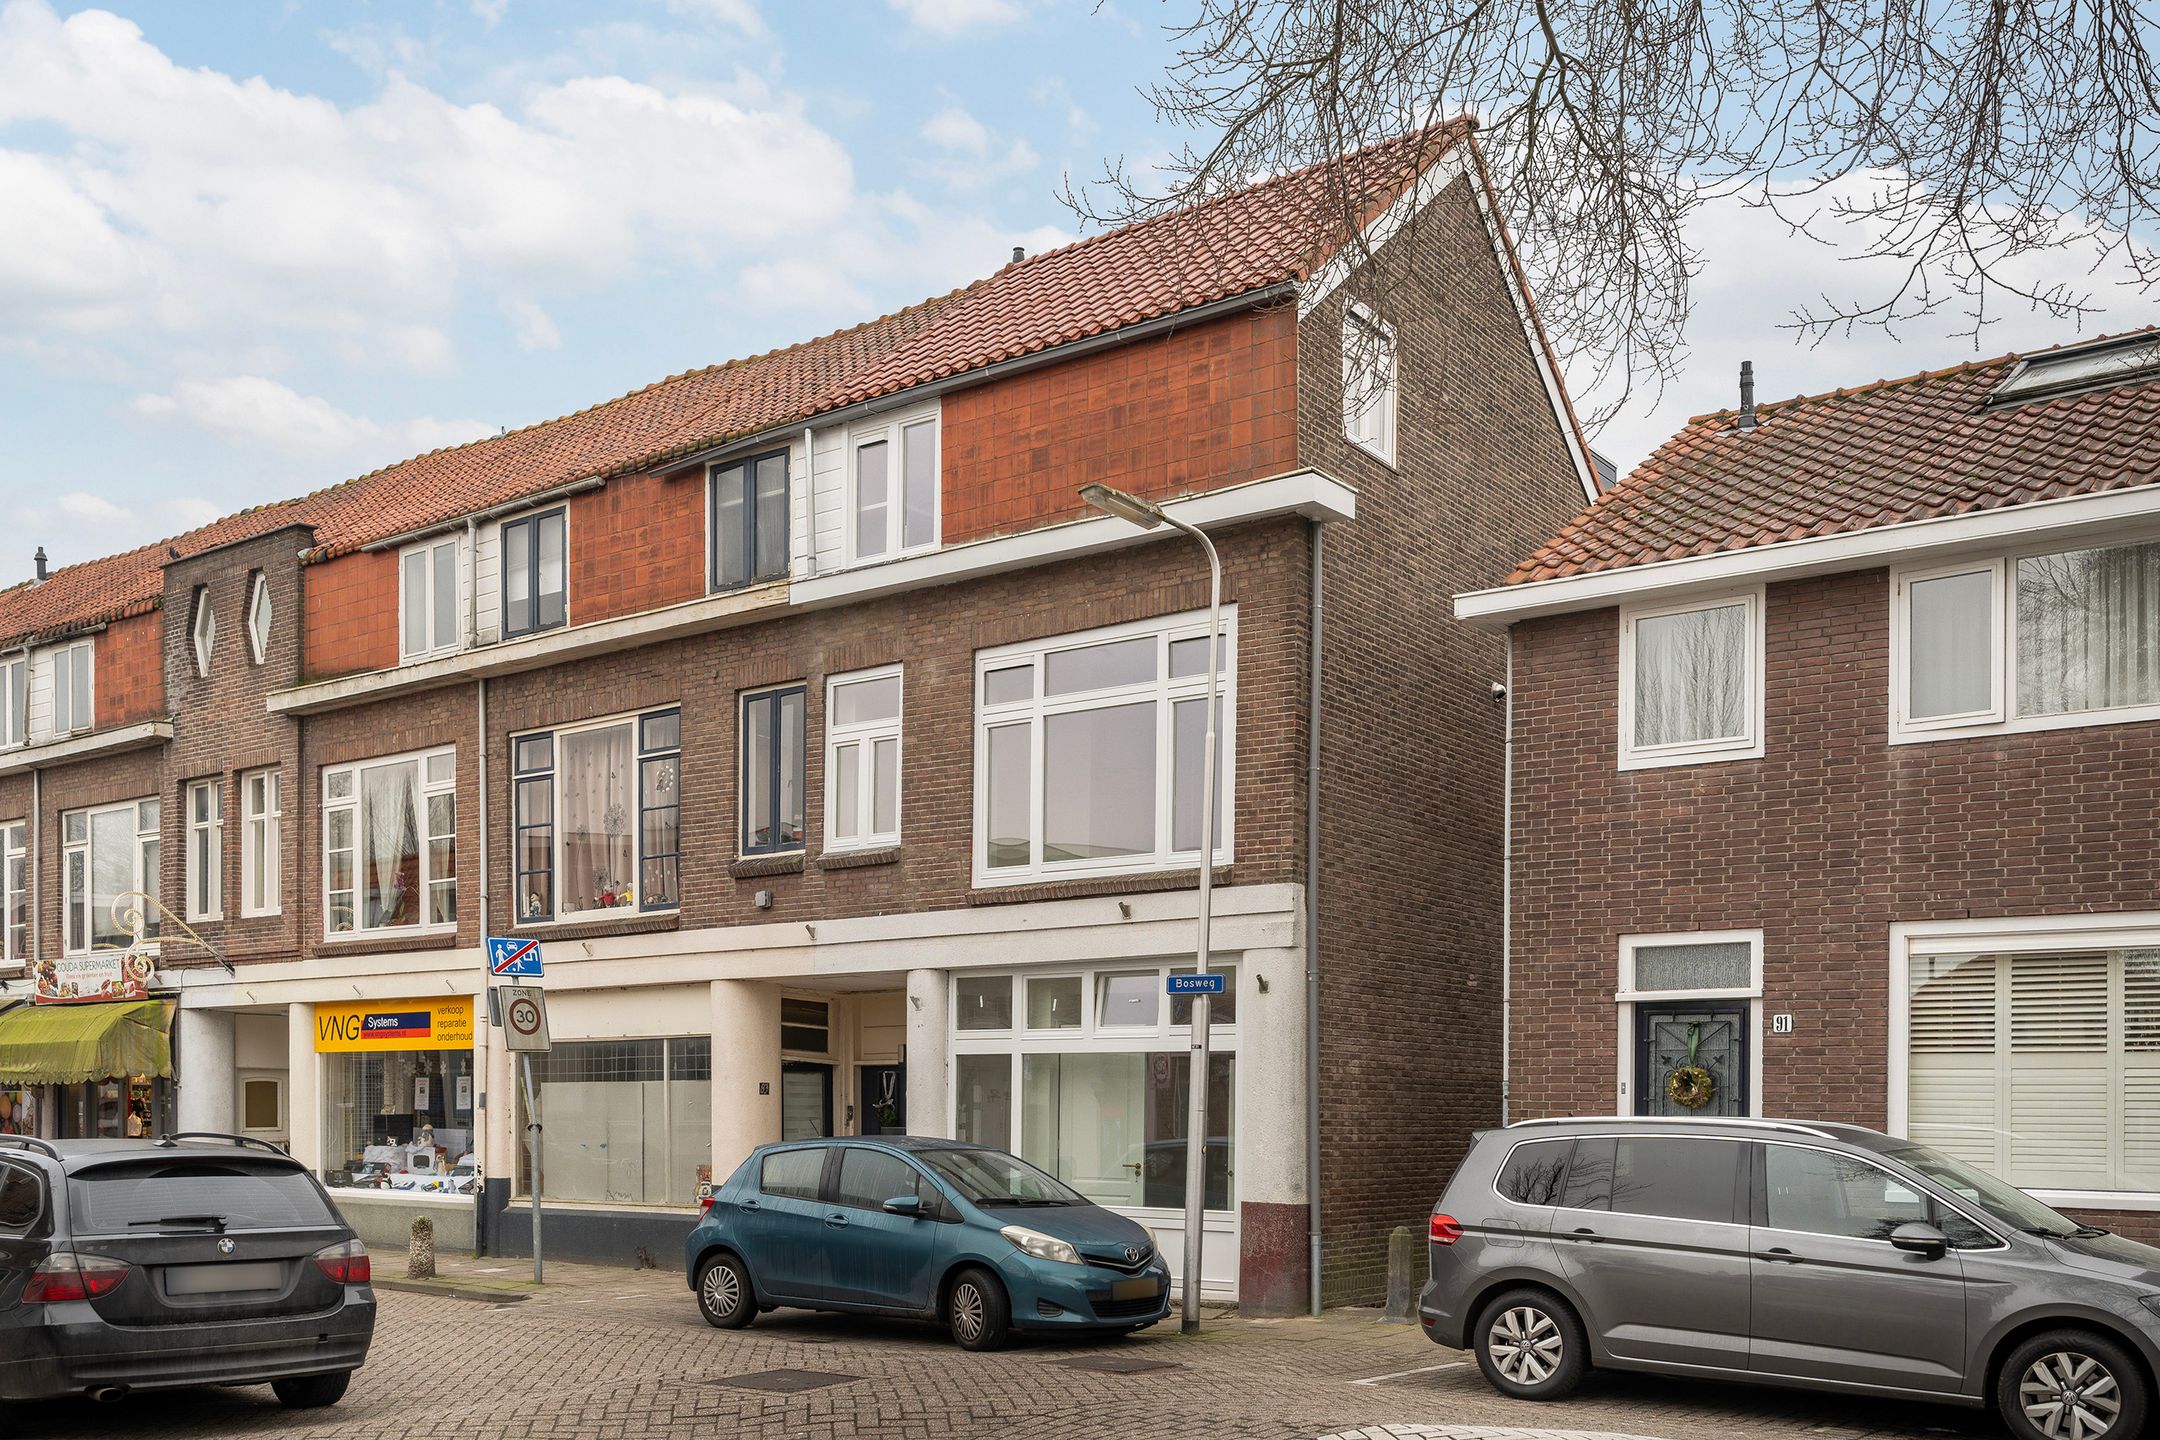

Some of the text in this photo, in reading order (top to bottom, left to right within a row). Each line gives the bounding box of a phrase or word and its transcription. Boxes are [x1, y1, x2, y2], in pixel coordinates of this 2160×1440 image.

[56, 958, 120, 973] GOUDA SUPERMARKET
[1175, 978, 1215, 990] Bosweg
[512, 989, 532, 997] ZONE
[437, 1005, 464, 1016] verkoop
[516, 1010, 535, 1024] 30
[318, 1014, 360, 1041] VNG
[368, 1016, 399, 1030] Systems
[437, 1021, 467, 1031] reparatie
[1776, 1016, 1788, 1031] 91
[437, 1031, 473, 1042] onderhoud
